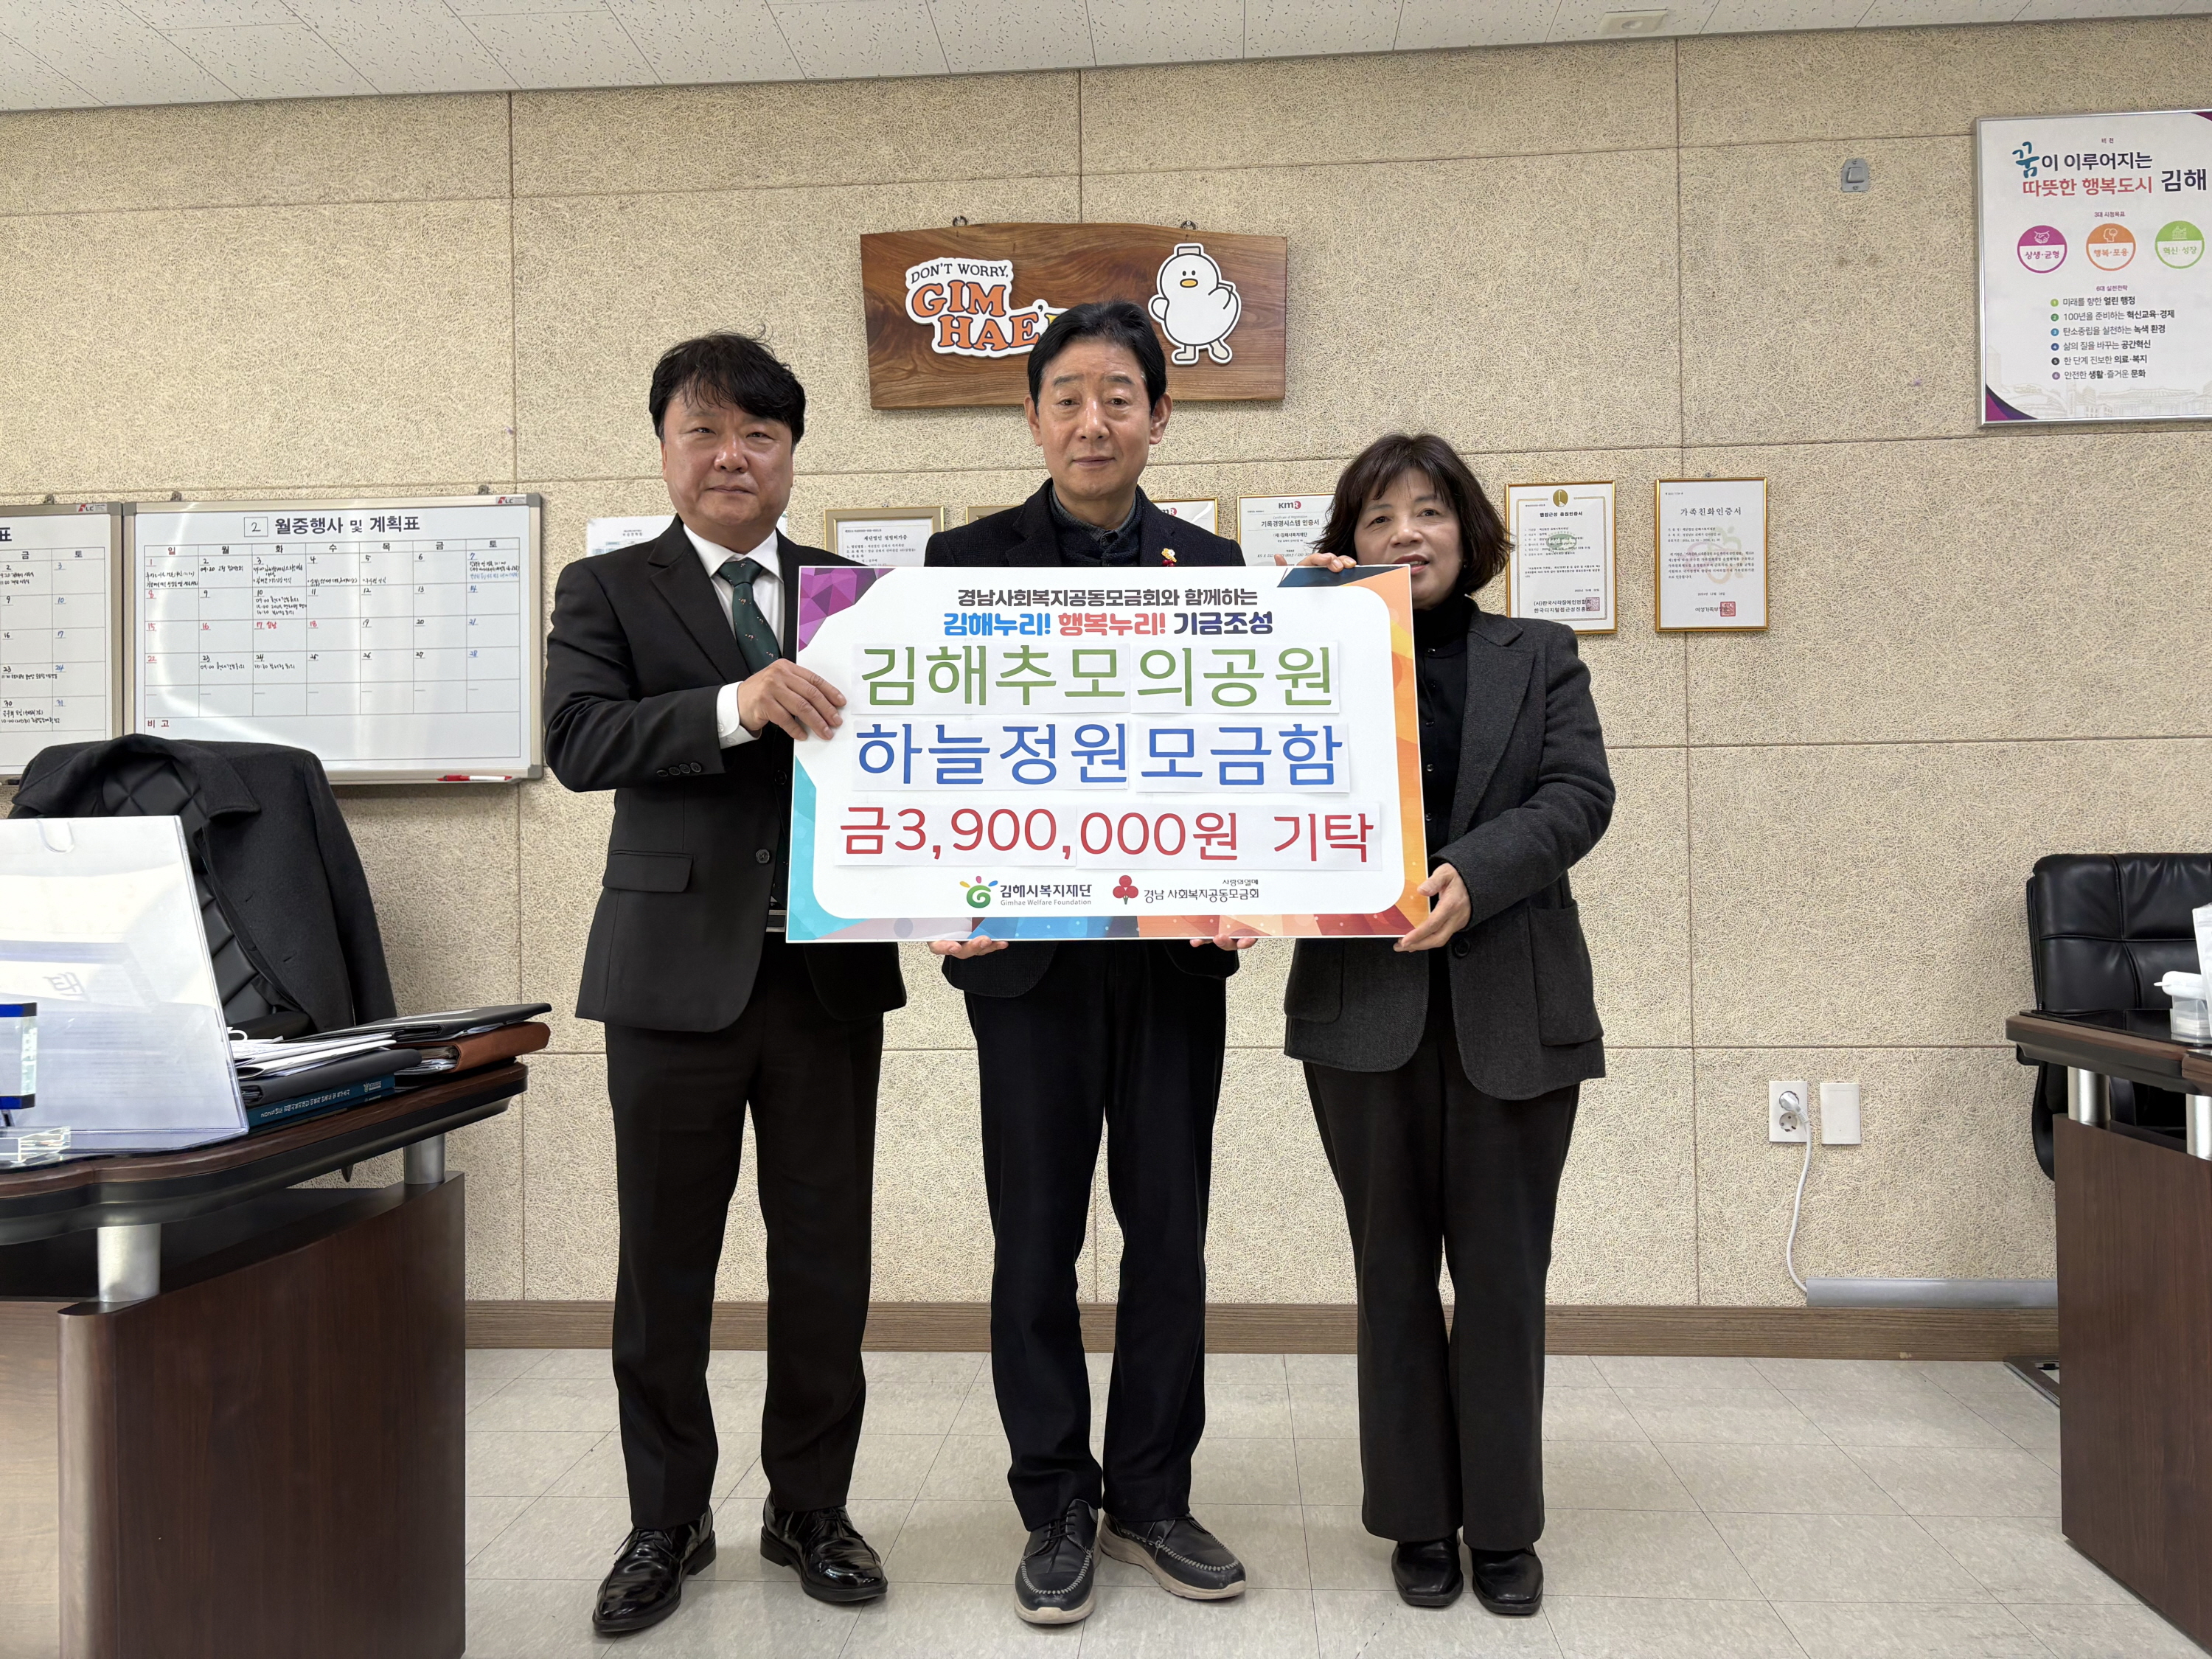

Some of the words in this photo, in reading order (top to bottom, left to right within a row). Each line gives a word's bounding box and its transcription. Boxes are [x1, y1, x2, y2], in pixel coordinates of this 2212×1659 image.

[2012, 141, 2058, 178] 꿈이
[2064, 151, 2153, 171] 이루어지는
[2023, 178, 2077, 197] 따뜻한
[2081, 176, 2152, 196] 행복도시
[2161, 168, 2207, 192] 김해
[911, 262, 953, 285] DON'T
[957, 262, 1009, 279] WORRY,
[911, 279, 1007, 319] GIM
[2063, 297, 2085, 307] 미래를
[2087, 296, 2102, 306] 향한
[2104, 296, 2118, 305] 열린
[2120, 296, 2135, 305] 행정
[2063, 312, 2093, 321] 100년을
[2096, 310, 2125, 320] 준비하는
[2063, 326, 2100, 336] 탄소중립을
[2102, 325, 2132, 335] 실천하는
[2134, 324, 2149, 334] 녹색
[2151, 324, 2166, 334] 환경
[2063, 341, 2079, 351] 삶의
[2080, 341, 2096, 350] 질을
[2097, 340, 2120, 349] 바꾸는
[2121, 339, 2151, 349] 공간혁신
[2064, 356, 2071, 366] 한
[2073, 356, 2088, 365] 단계
[2090, 355, 2112, 365] 진보한
[2065, 371, 2087, 380] 안전한
[2131, 369, 2146, 378] 문화
[1680, 507, 1742, 516] 가족친화인증서
[251, 521, 261, 533] 2
[275, 516, 343, 535] 월중행사
[349, 518, 363, 533] 및
[369, 515, 420, 534] 계획표
[1261, 519, 1301, 528] 기록경영시스템
[167, 546, 175, 555] 일
[276, 545, 283, 553] 화
[329, 544, 337, 553] 수
[383, 543, 390, 551] 목
[436, 541, 444, 550] 금
[489, 540, 497, 548] 토
[21, 551, 29, 560] 금
[74, 550, 83, 558] 토
[310, 556, 316, 564] 4
[7, 595, 10, 604] 9
[204, 590, 208, 598] 9
[959, 589, 1179, 607] 경남사회복지공동모금회와
[1185, 588, 1258, 606] 함께하는
[202, 622, 209, 630] 16
[943, 612, 1051, 636] 김해누리!
[1058, 612, 1166, 636] 행복누리!
[1173, 611, 1273, 636] 기금조성
[58, 630, 63, 639] 17
[861, 644, 1333, 707] 김해추모의공원
[147, 719, 156, 728] 비
[161, 720, 169, 728] 고
[856, 723, 1343, 787] 하늘정원모금함
[840, 807, 1239, 861] 금3,900,000원
[1273, 813, 1374, 863] 기탁
[1000, 883, 1092, 899] 김해시복지재단
[1144, 888, 1165, 904] 경남
[1167, 888, 1259, 903] 사회복지공동모금회
